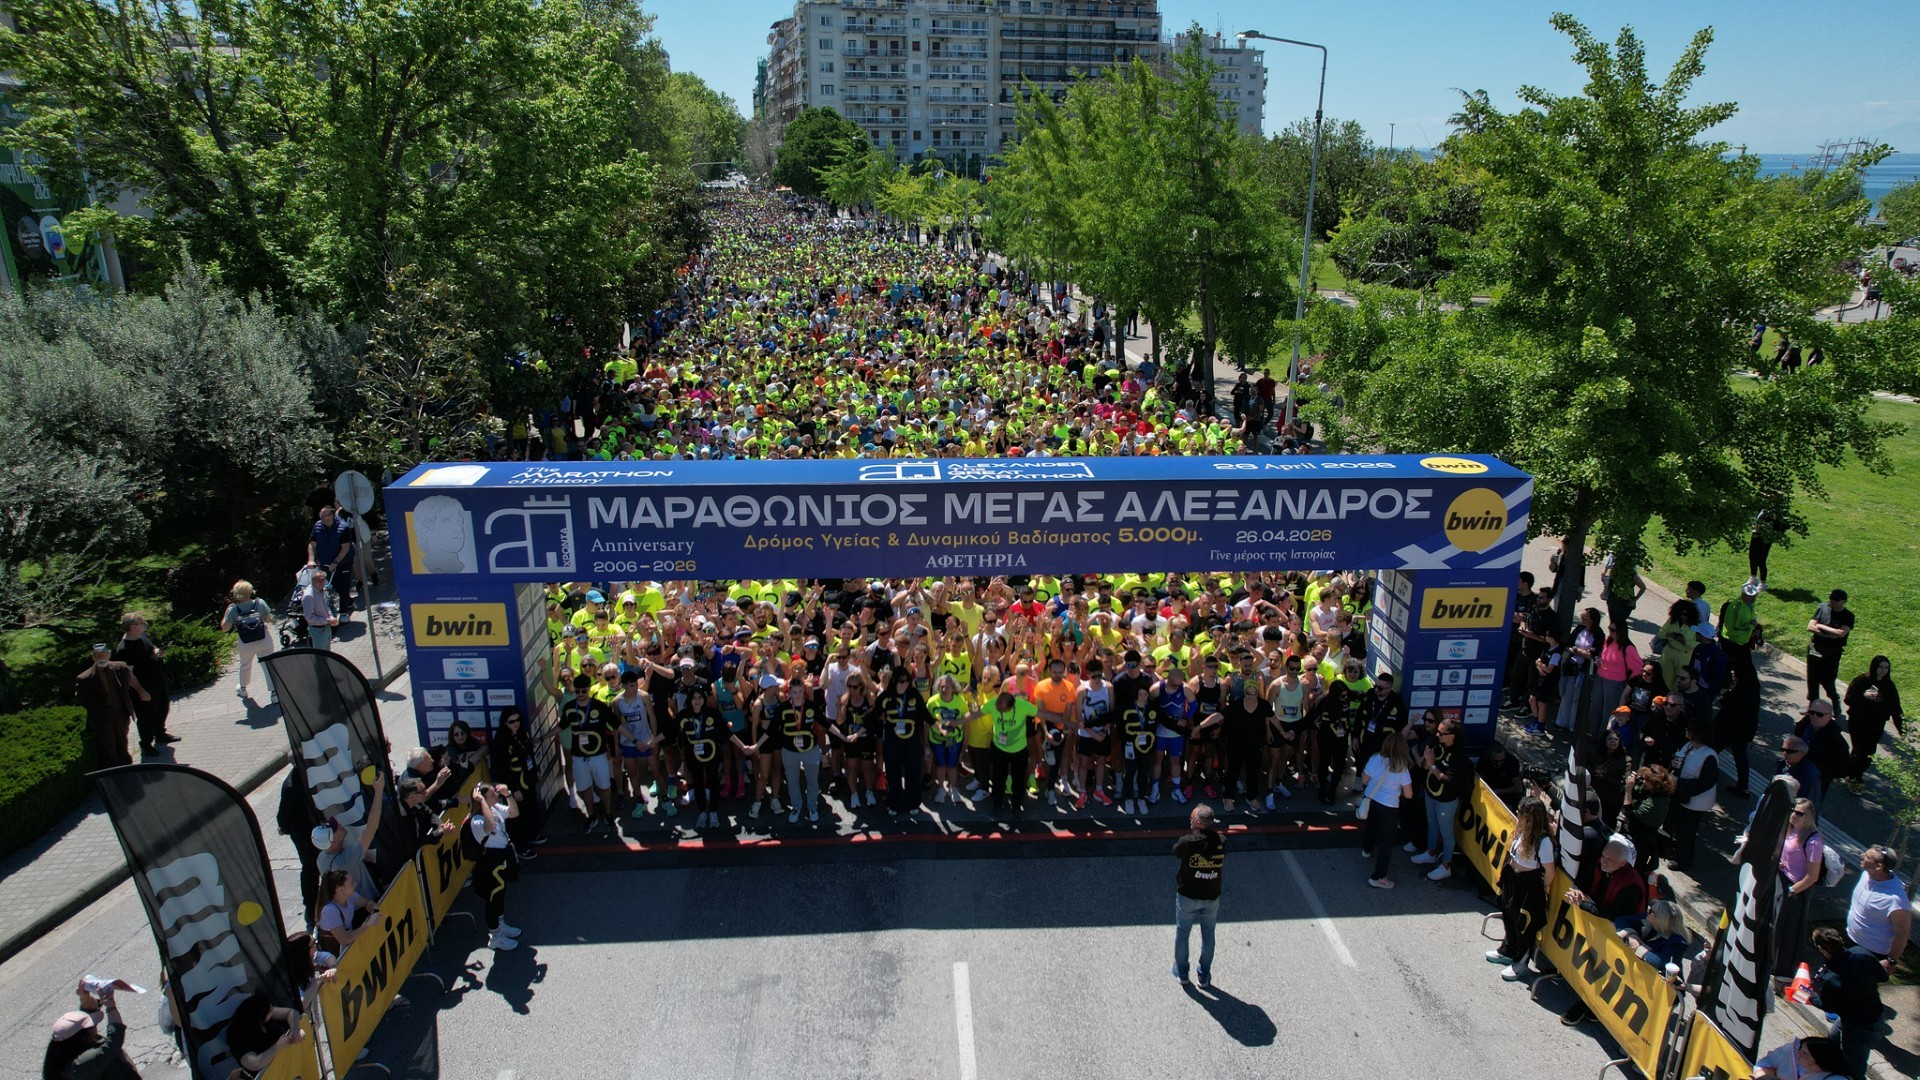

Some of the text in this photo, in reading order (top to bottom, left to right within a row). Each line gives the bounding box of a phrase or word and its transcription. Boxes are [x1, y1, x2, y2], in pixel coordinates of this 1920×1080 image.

[511, 470, 674, 479] MARATHON
[1264, 462, 1318, 471] April
[587, 487, 1434, 529] ΜΑΡΑΘΩΝΙΟΣ ΜΕΓΑΣ ΑΛΕΞΑΝΔΡΟΣ
[1446, 510, 1503, 531] bwin
[590, 538, 695, 555] Anniversary
[744, 533, 814, 551] Δρόμος
[821, 532, 880, 550] Υγείας
[887, 532, 900, 546] &
[907, 531, 1001, 549] Δυναμικού
[1008, 529, 1111, 546] Βαδίσματος
[1235, 529, 1332, 544] 26.04.2026
[924, 552, 1028, 568] ΑΦΕΤΗΡΙΑ
[1209, 549, 1336, 562] Γίνε μέρος της Ιστορίας
[1431, 597, 1491, 620] bwin
[425, 613, 492, 636] bwin
[1457, 798, 1512, 870] bwi
[1194, 870, 1219, 880] bwin
[340, 907, 414, 1043] bwin
[1551, 899, 1650, 1037] bwin
